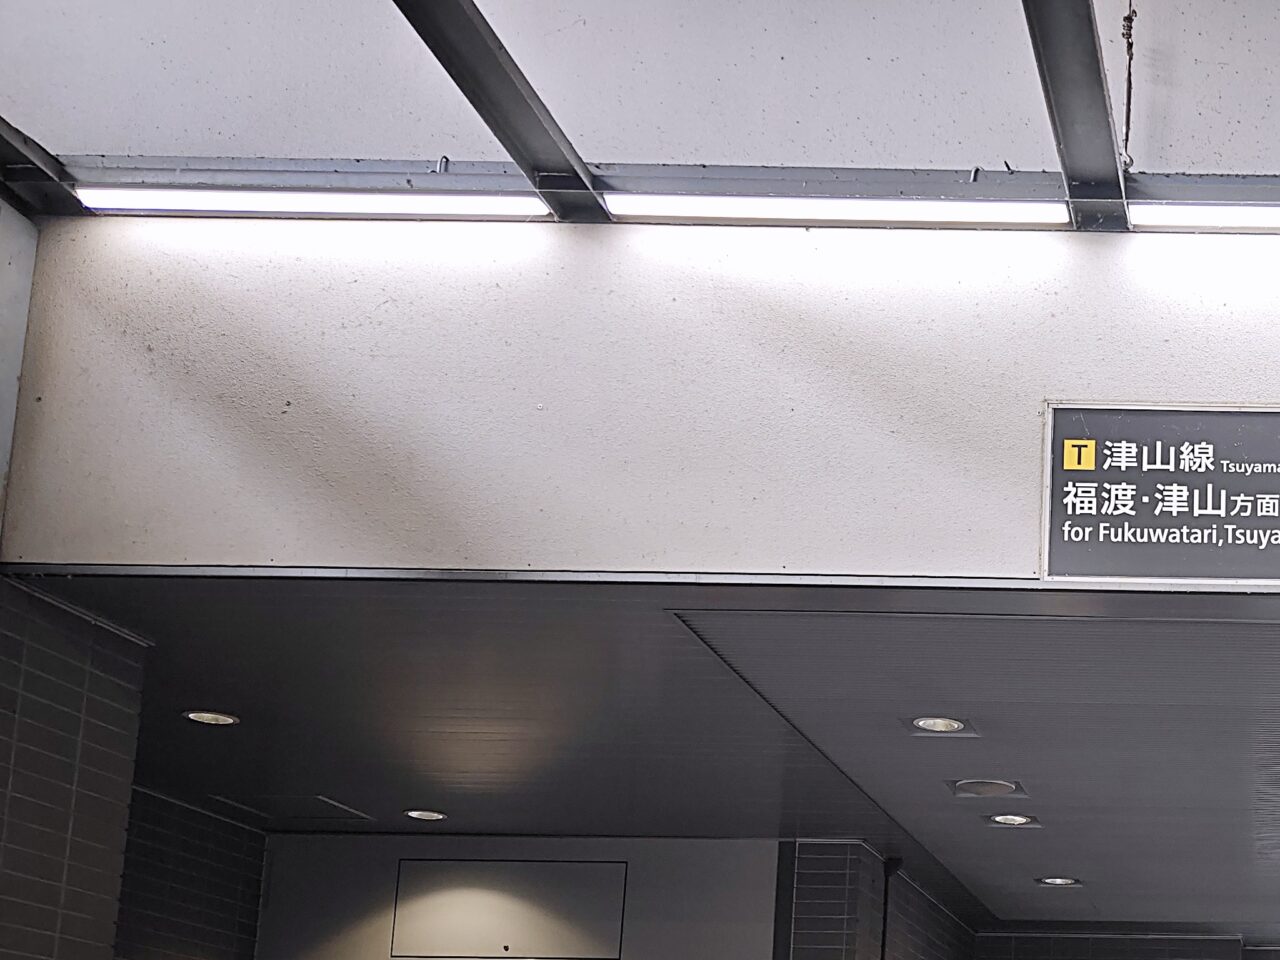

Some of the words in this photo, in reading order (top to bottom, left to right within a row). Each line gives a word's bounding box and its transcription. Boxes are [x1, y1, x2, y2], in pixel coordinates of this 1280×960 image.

[1072, 445, 1089, 466] T
[1102, 440, 1214, 473] 津山線
[1062, 522, 1094, 543] for
